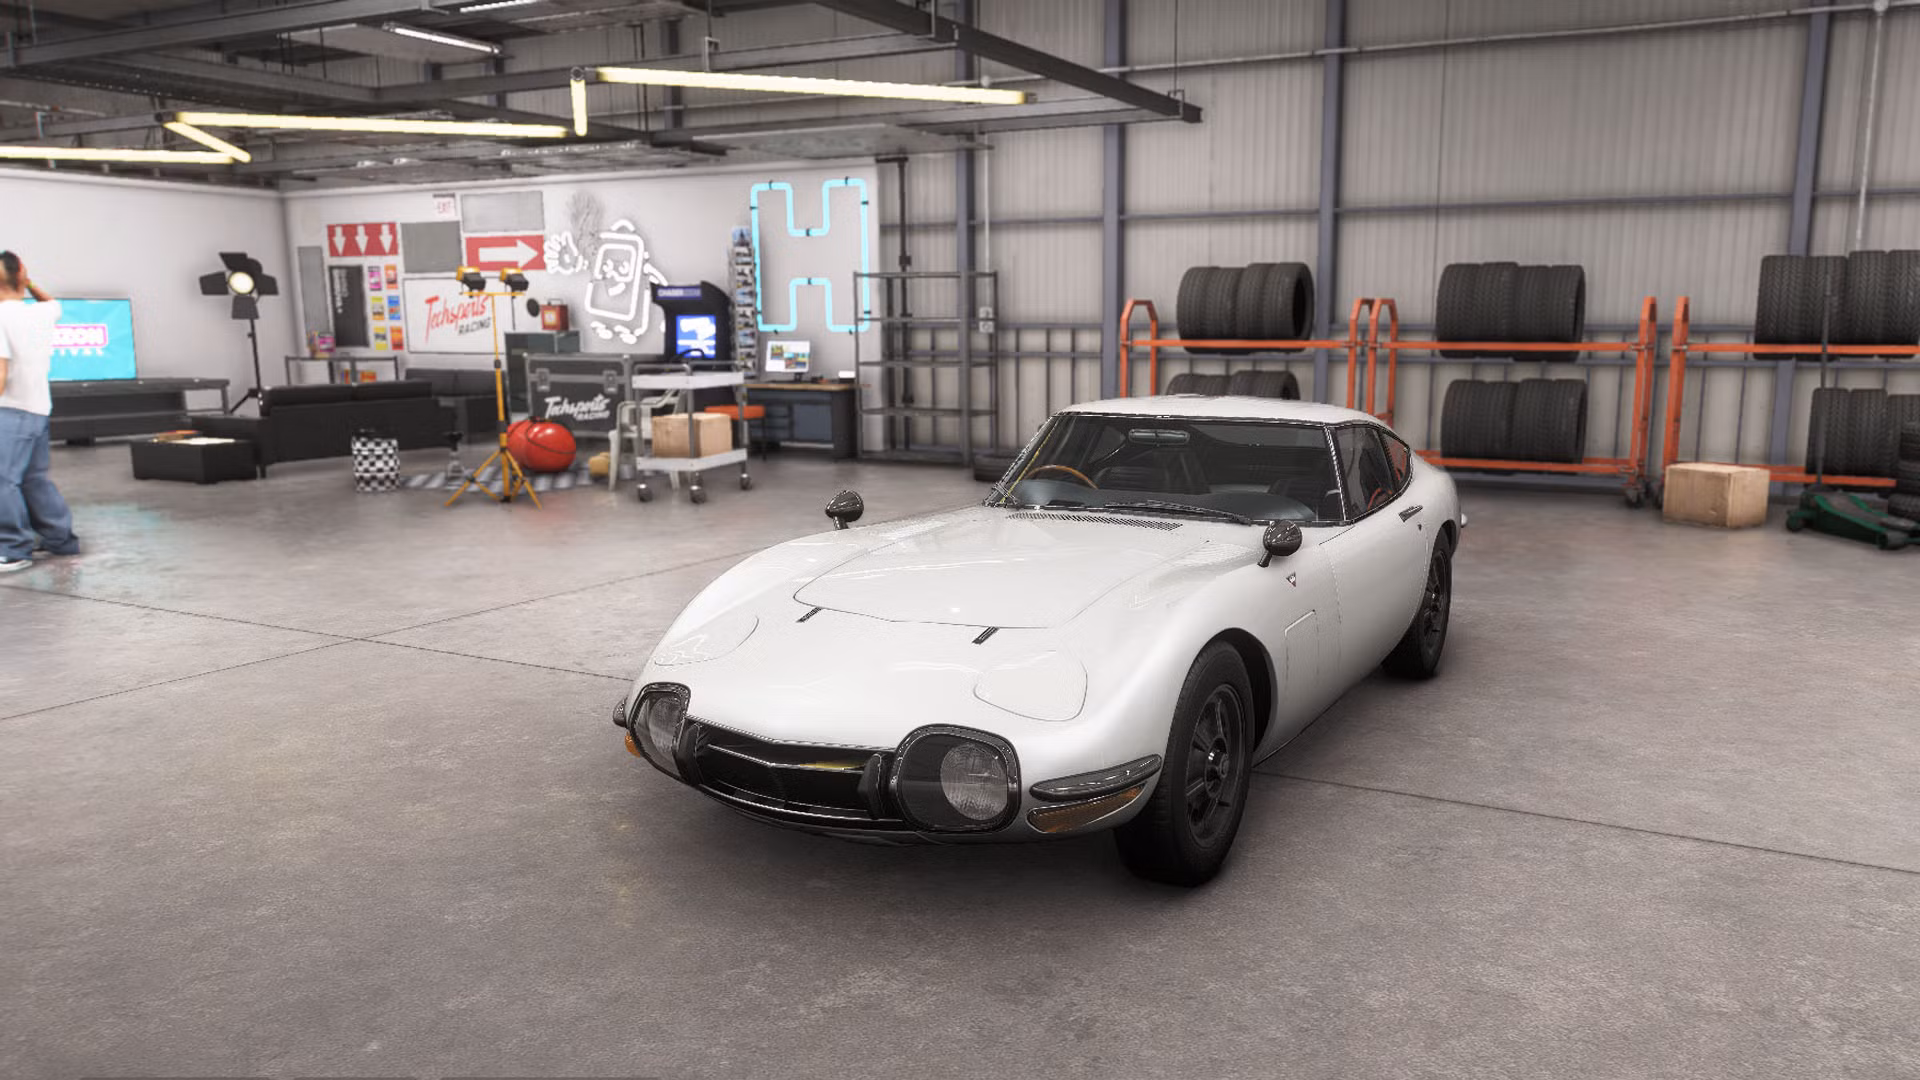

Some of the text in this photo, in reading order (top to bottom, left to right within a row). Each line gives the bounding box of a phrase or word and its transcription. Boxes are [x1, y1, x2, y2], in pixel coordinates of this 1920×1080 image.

[425, 294, 490, 345] Techsports
[458, 317, 491, 336] RACING
[544, 394, 611, 419] Techsports
